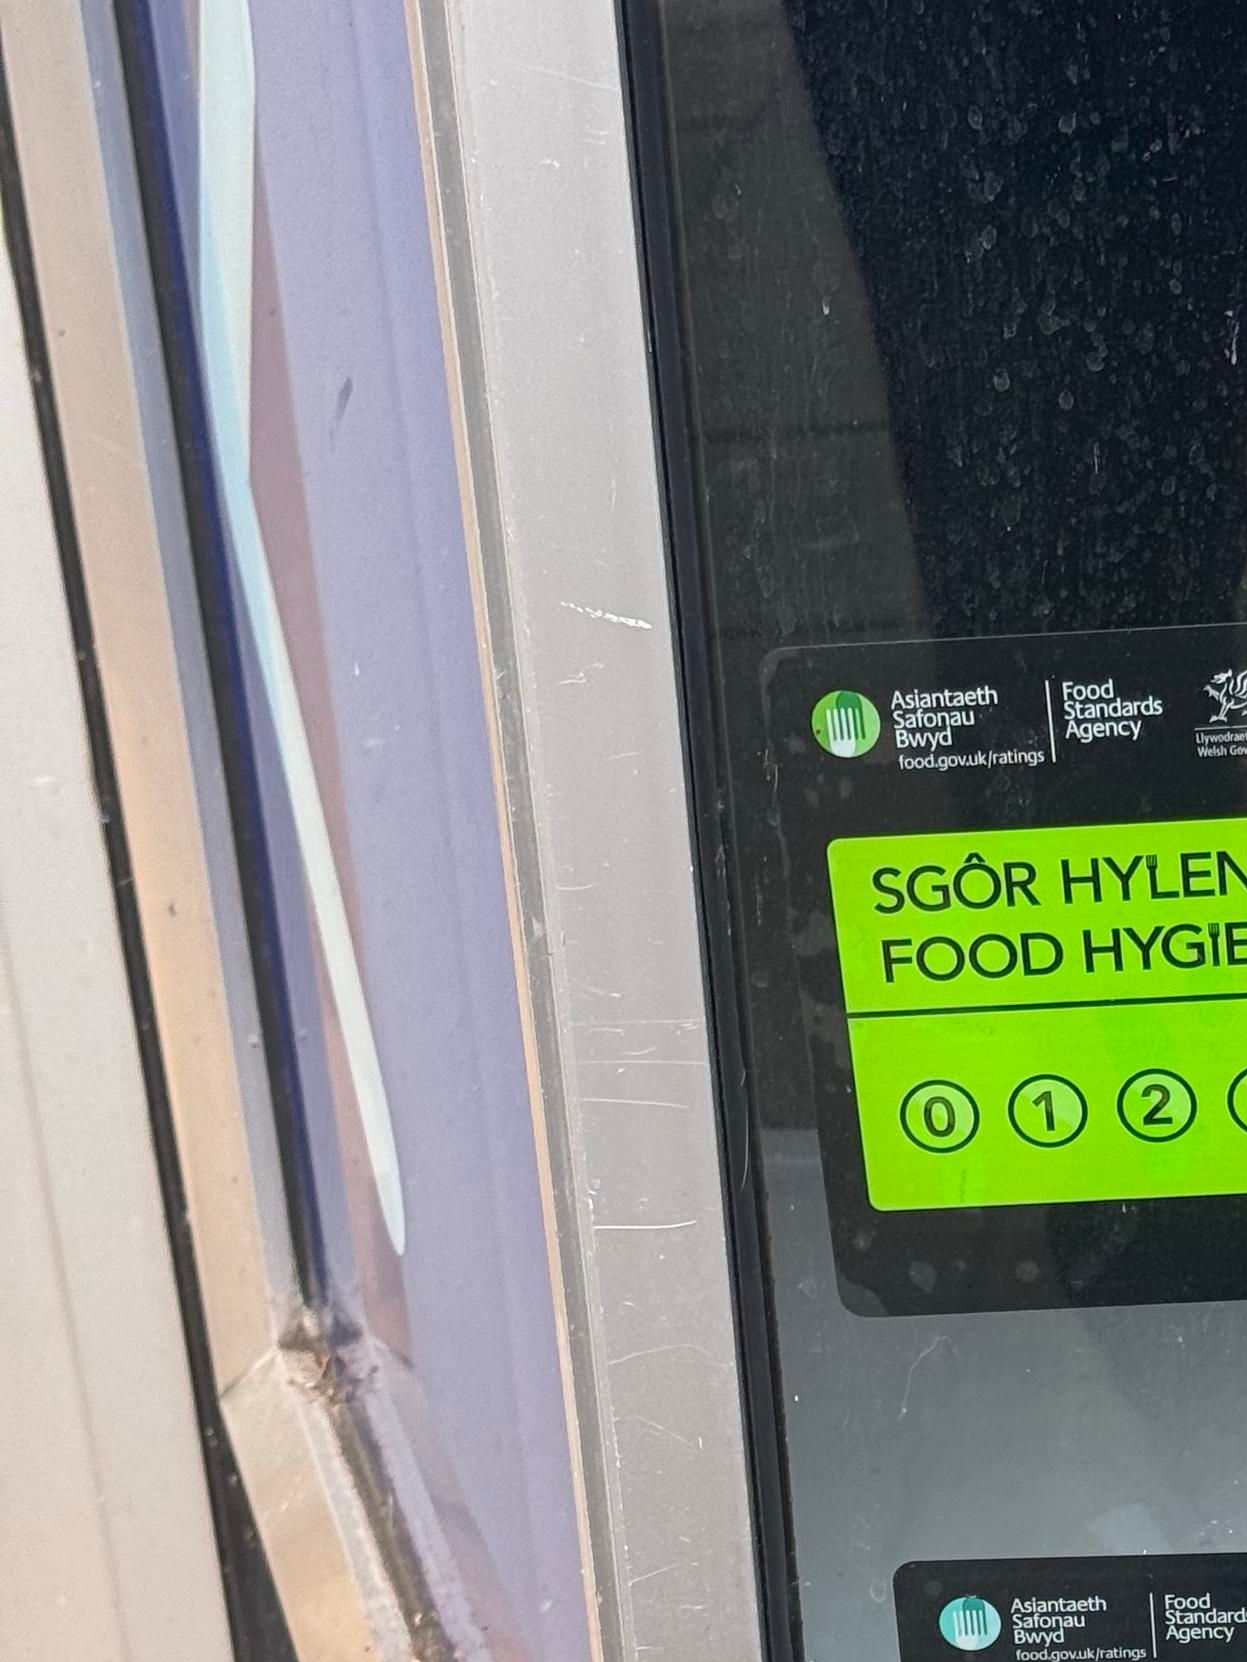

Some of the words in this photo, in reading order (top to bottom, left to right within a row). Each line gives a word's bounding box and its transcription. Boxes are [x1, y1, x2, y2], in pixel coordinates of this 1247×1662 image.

[891, 686, 998, 710] Asiantaeth
[1063, 679, 1114, 700] Food
[1064, 697, 1163, 719] Standards
[893, 710, 975, 728] Safonau
[896, 726, 952, 749] Bwyd
[1066, 719, 1142, 743] Agency
[898, 749, 1044, 771] food.gov.uk/ratings
[1198, 744, 1227, 756] Welsh
[872, 852, 1040, 915] SGÔR
[881, 932, 1063, 983] FOOD
[925, 1097, 954, 1138] 0
[1031, 1092, 1057, 1132] 1
[1141, 1084, 1173, 1125] 2
[1011, 1596, 1106, 1614] Asiantaeth
[1164, 1593, 1210, 1610] Food
[1012, 1613, 1085, 1629] Safonau
[1014, 1628, 1064, 1647] Bwyd
[1166, 1625, 1234, 1644] Agency
[1016, 1647, 1146, 1662] food.gov.uk/ratings
